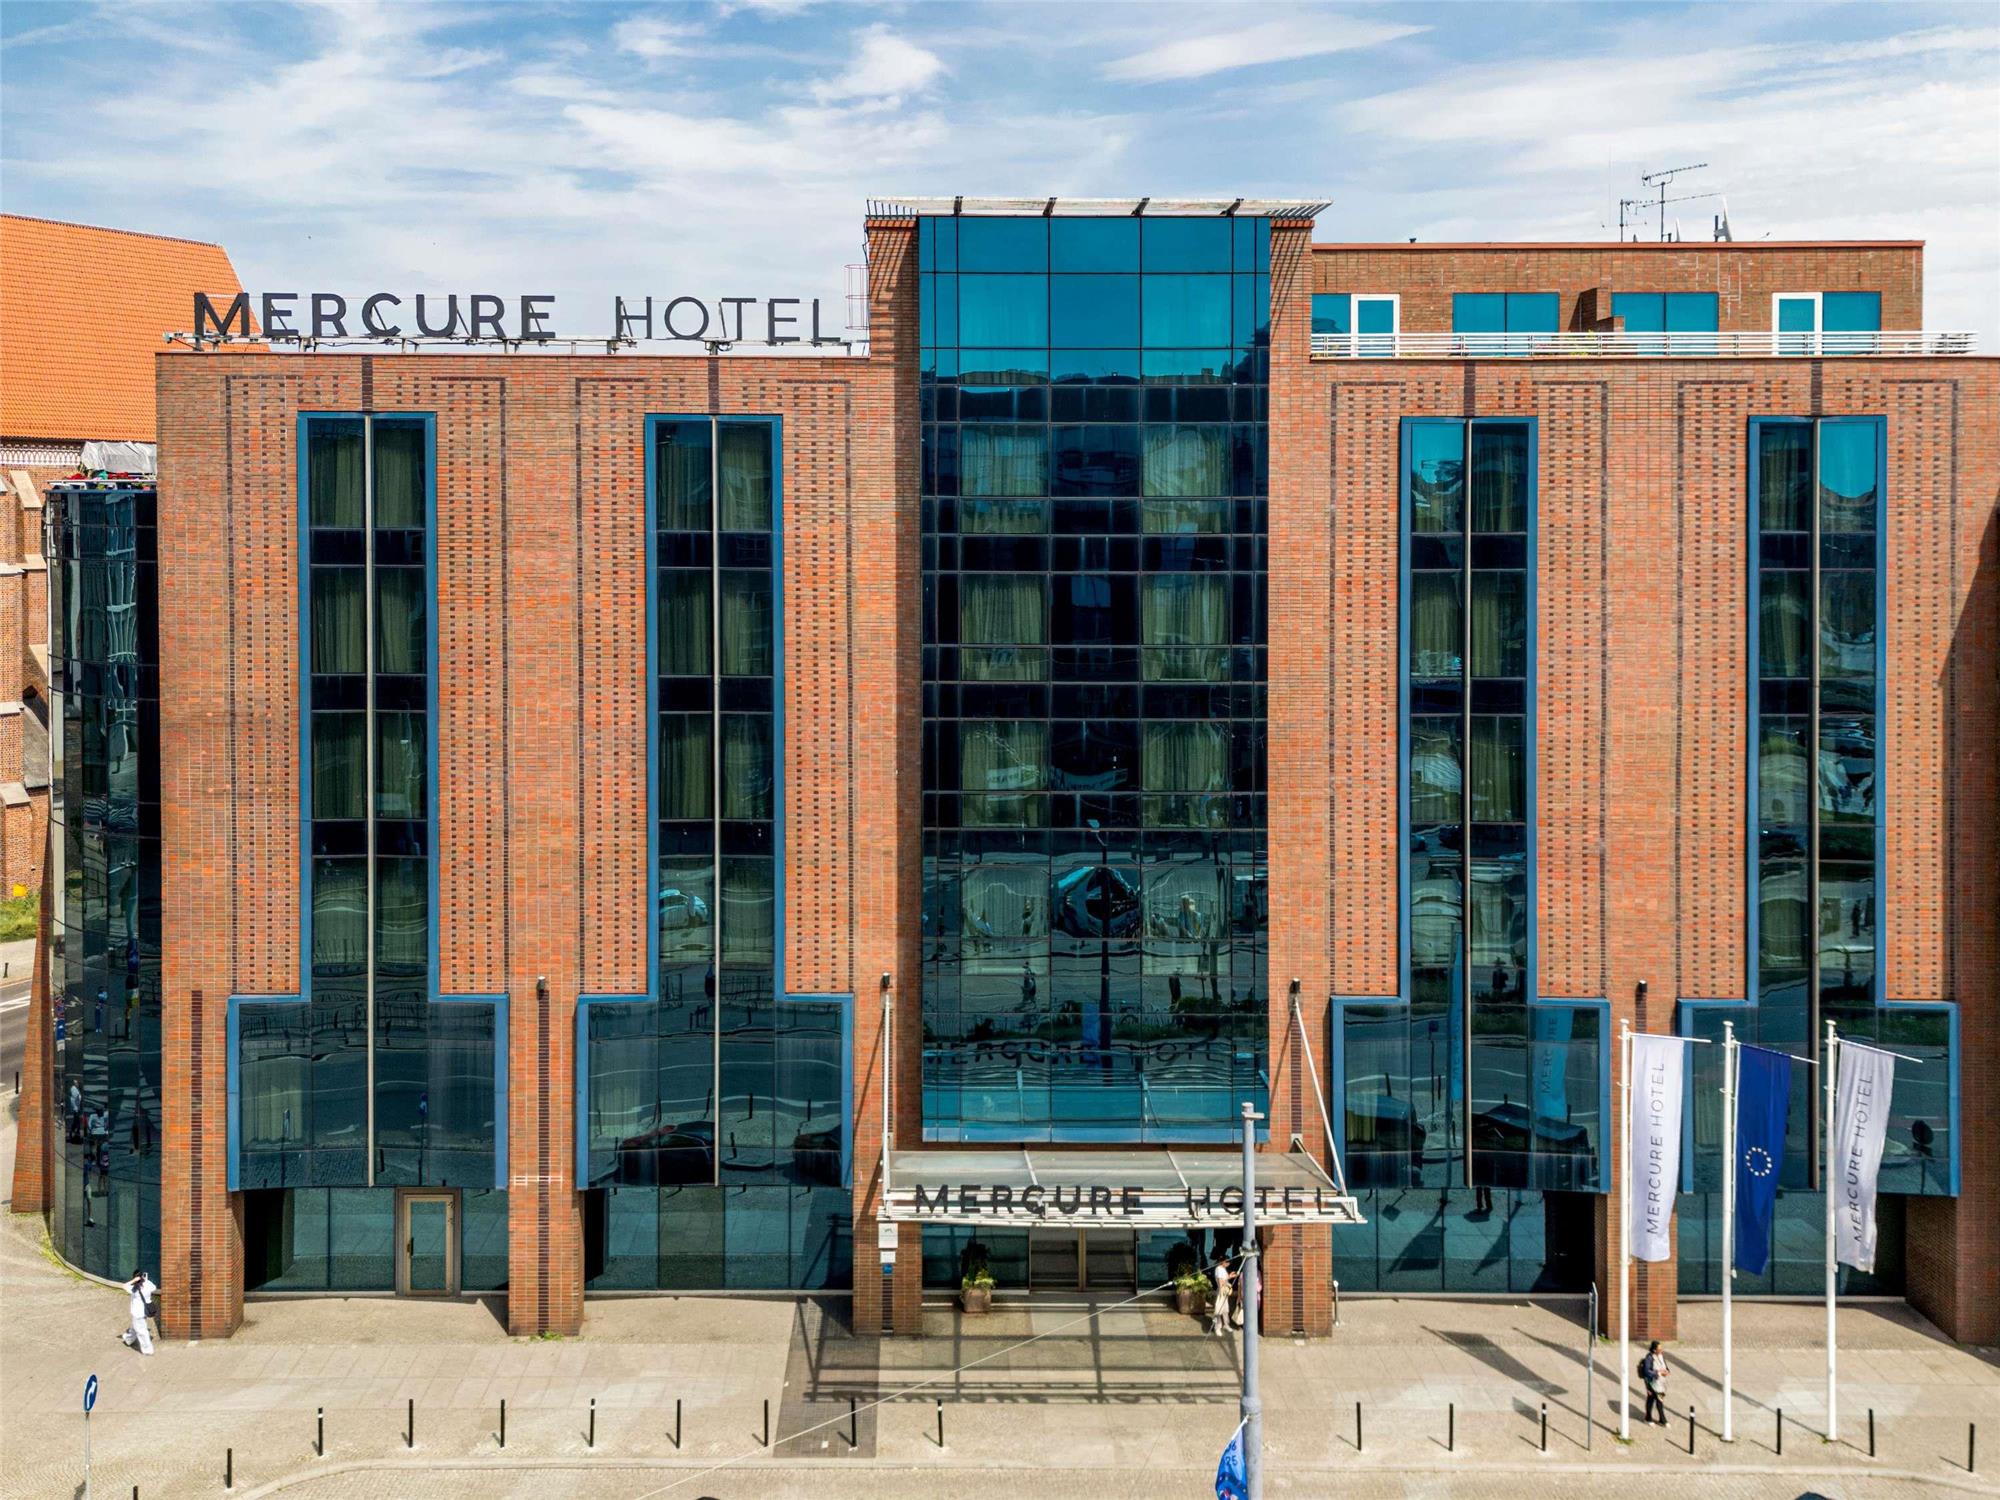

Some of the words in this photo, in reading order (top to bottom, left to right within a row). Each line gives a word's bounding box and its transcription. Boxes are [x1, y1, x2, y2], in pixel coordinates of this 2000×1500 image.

[194, 292, 555, 339] MERCURE
[615, 296, 841, 343] HOTEL
[1651, 1062, 1666, 1128] HOTEL
[1853, 1073, 1873, 1137] HOTEL
[915, 1184, 1144, 1215] MERCURE
[1187, 1185, 1335, 1215] HOTEL
[1646, 1136, 1664, 1236] MERCURE
[1846, 1149, 1864, 1243] MERCURE
